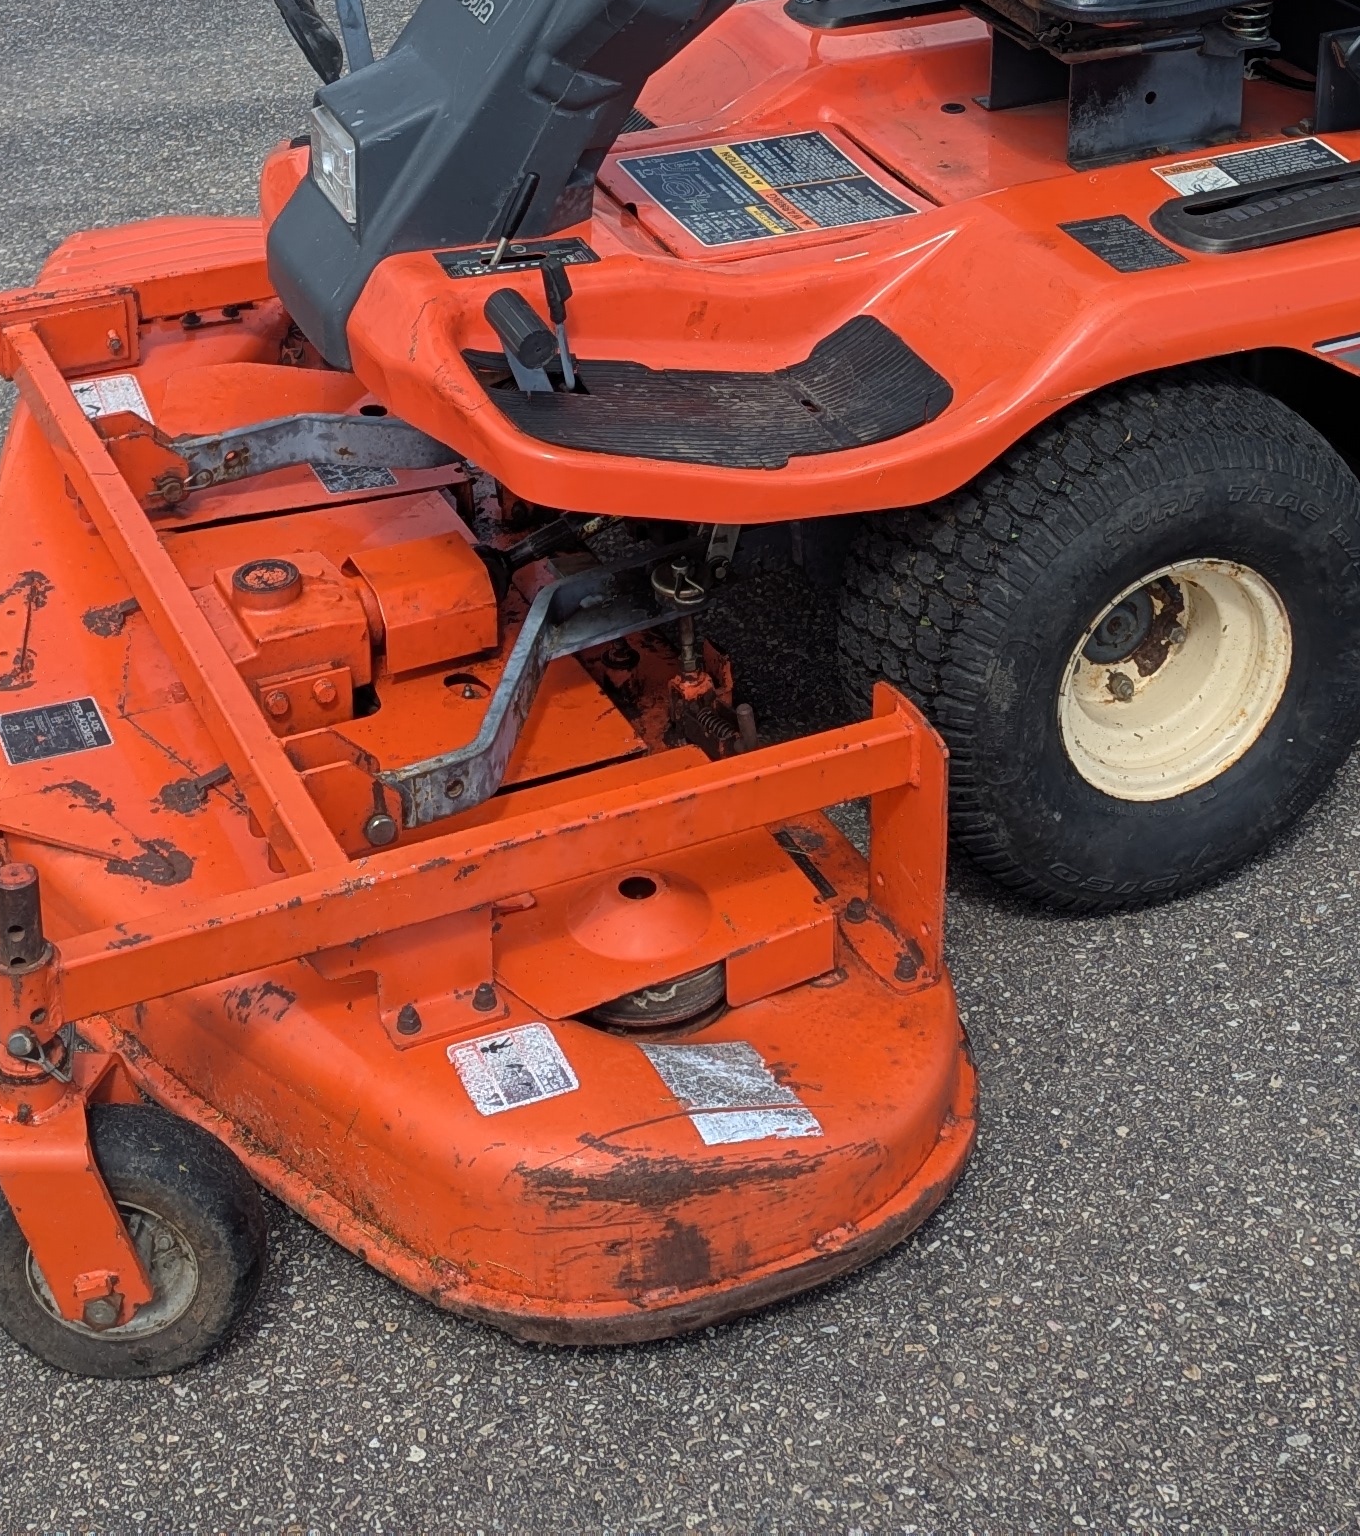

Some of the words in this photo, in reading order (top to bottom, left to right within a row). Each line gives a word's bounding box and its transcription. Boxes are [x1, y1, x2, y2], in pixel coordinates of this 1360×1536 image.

[720, 151, 756, 179] CAUTION
[766, 193, 804, 220] WARNING
[1102, 486, 1205, 550] TURF
[1227, 484, 1325, 523] TRAC
[71, 701, 98, 746] REPLACEMENT
[85, 711, 103, 733] BLADE
